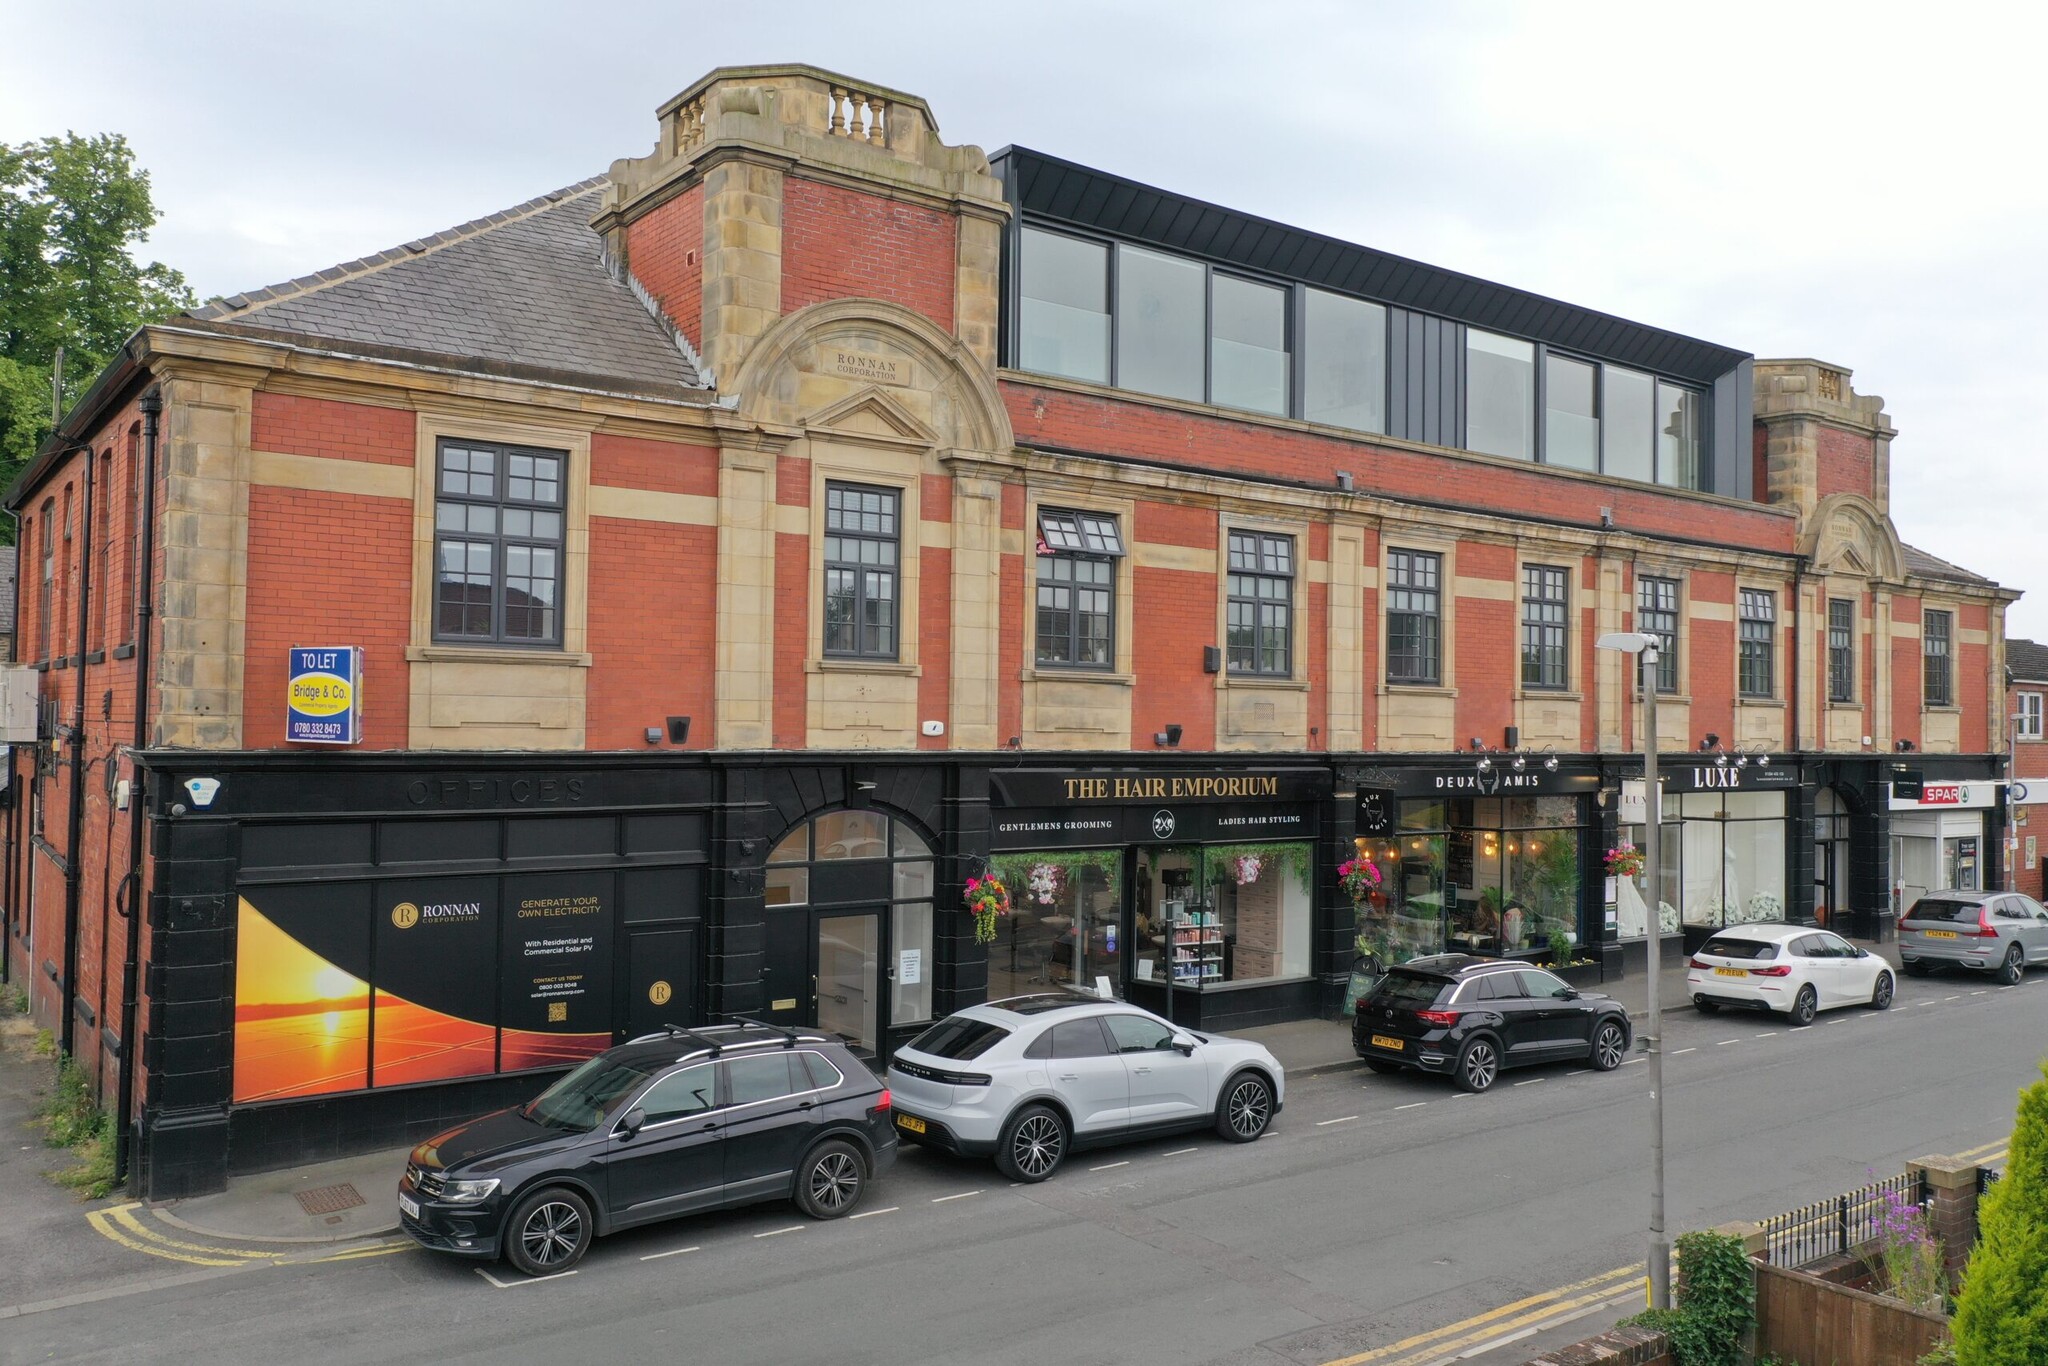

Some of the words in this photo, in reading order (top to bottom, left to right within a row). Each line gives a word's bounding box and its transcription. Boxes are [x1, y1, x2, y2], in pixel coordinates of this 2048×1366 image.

[837, 354, 896, 371] RONNAN
[837, 365, 896, 380] CORPORATION
[302, 653, 315, 669] TO
[317, 653, 337, 669] LET
[294, 684, 320, 700] Bridge
[323, 685, 329, 698] &
[332, 685, 346, 699] Co.
[294, 722, 310, 733] 0780
[311, 722, 323, 734] 332
[324, 723, 341, 735] 8473
[1436, 776, 1475, 788] DEUX
[1504, 775, 1538, 787] AMIS
[1694, 767, 1740, 788] LUXE
[407, 778, 585, 805] OFFICES
[1064, 778, 1108, 799] THE
[1113, 777, 1166, 798] HAIR
[1171, 776, 1278, 797] EMPORIUM
[1927, 788, 1959, 801] SPAR
[999, 822, 1061, 832] GENTLEMENS
[1064, 820, 1113, 830] GROOMING
[1218, 817, 1246, 826] LADIES
[1248, 816, 1267, 825] HAIR
[1269, 815, 1300, 824] STYLING
[521, 898, 571, 909] GENERATE
[573, 896, 598, 905] YOUR
[423, 902, 480, 918] RONNAN
[517, 909, 541, 918] OWN
[544, 905, 601, 917] ELECTRICITY
[422, 915, 479, 924] CORPORATION
[542, 937, 579, 947] Residential
[524, 946, 564, 956] Commercial
[565, 945, 582, 953] Solar
[533, 976, 557, 984] CONTACT
[530, 989, 585, 998] solar@ronnancorp.com
